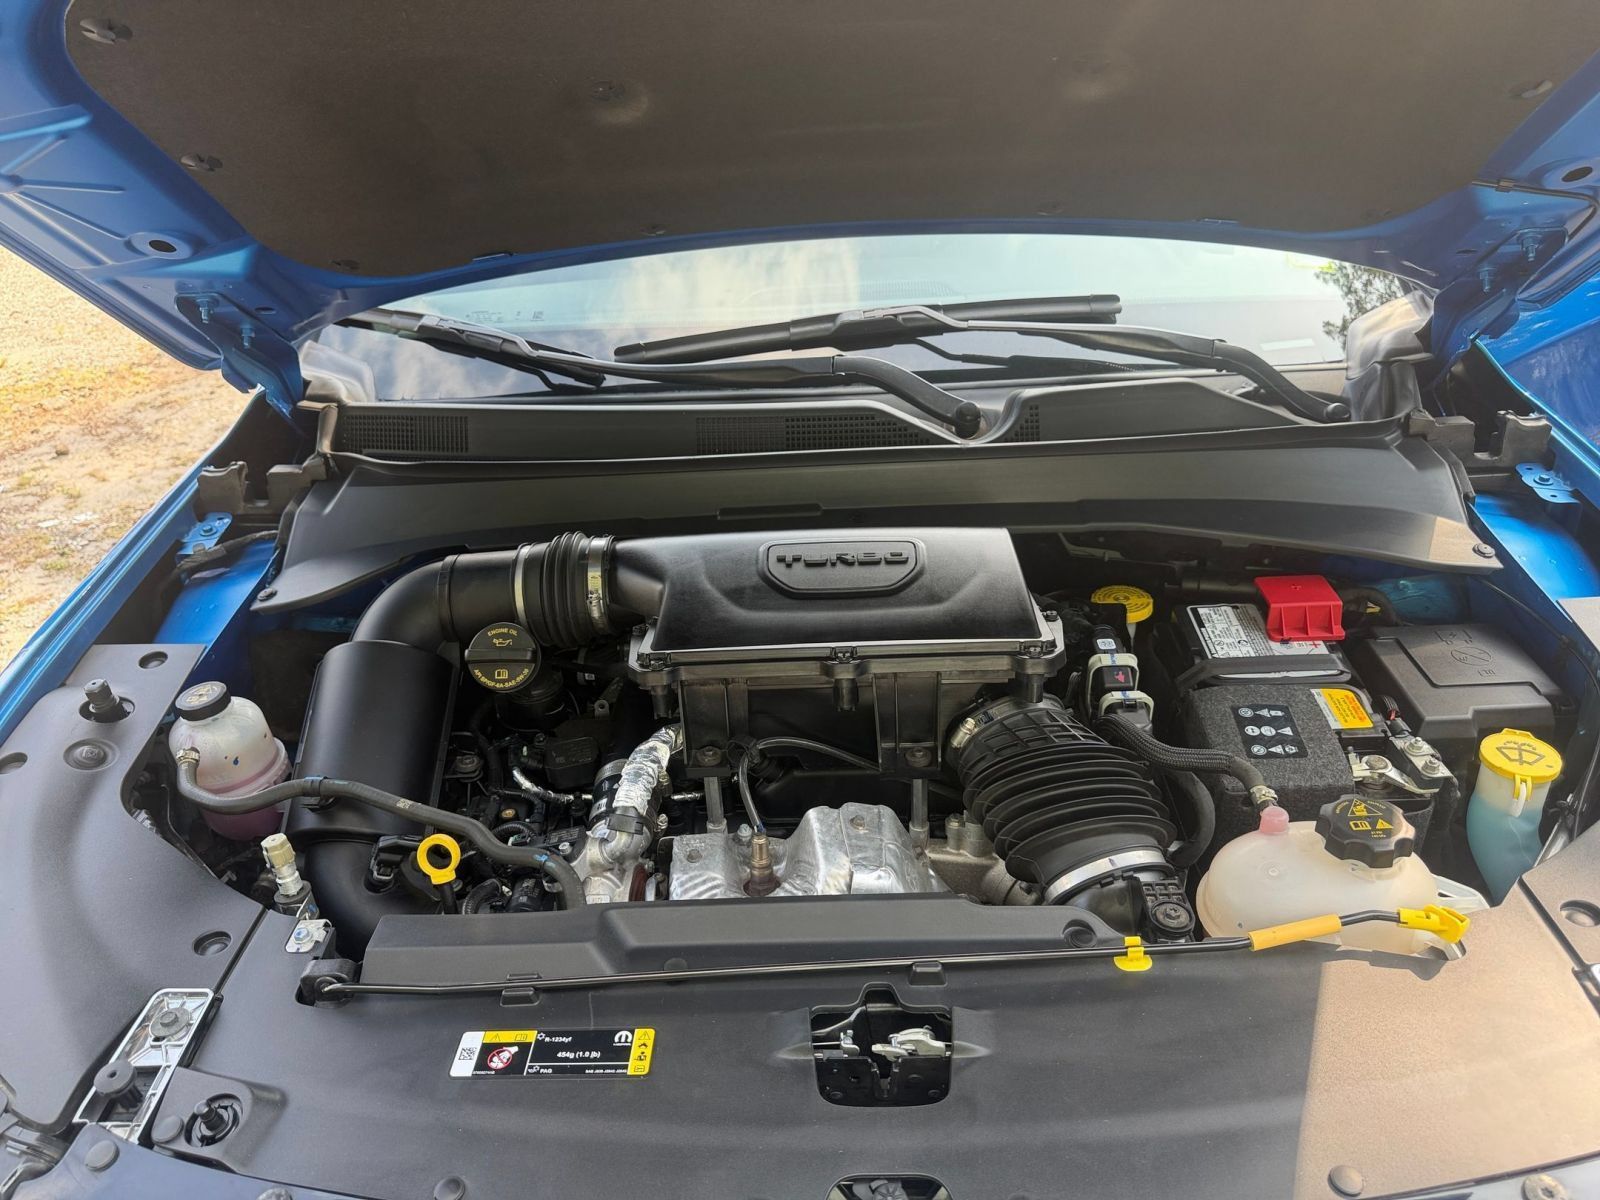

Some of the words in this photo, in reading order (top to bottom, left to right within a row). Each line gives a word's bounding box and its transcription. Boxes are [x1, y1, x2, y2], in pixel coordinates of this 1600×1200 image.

[776, 551, 909, 569] TURBO
[487, 628, 508, 637] ENGINE
[509, 628, 518, 637] OIL
[556, 1051, 575, 1059] 454g
